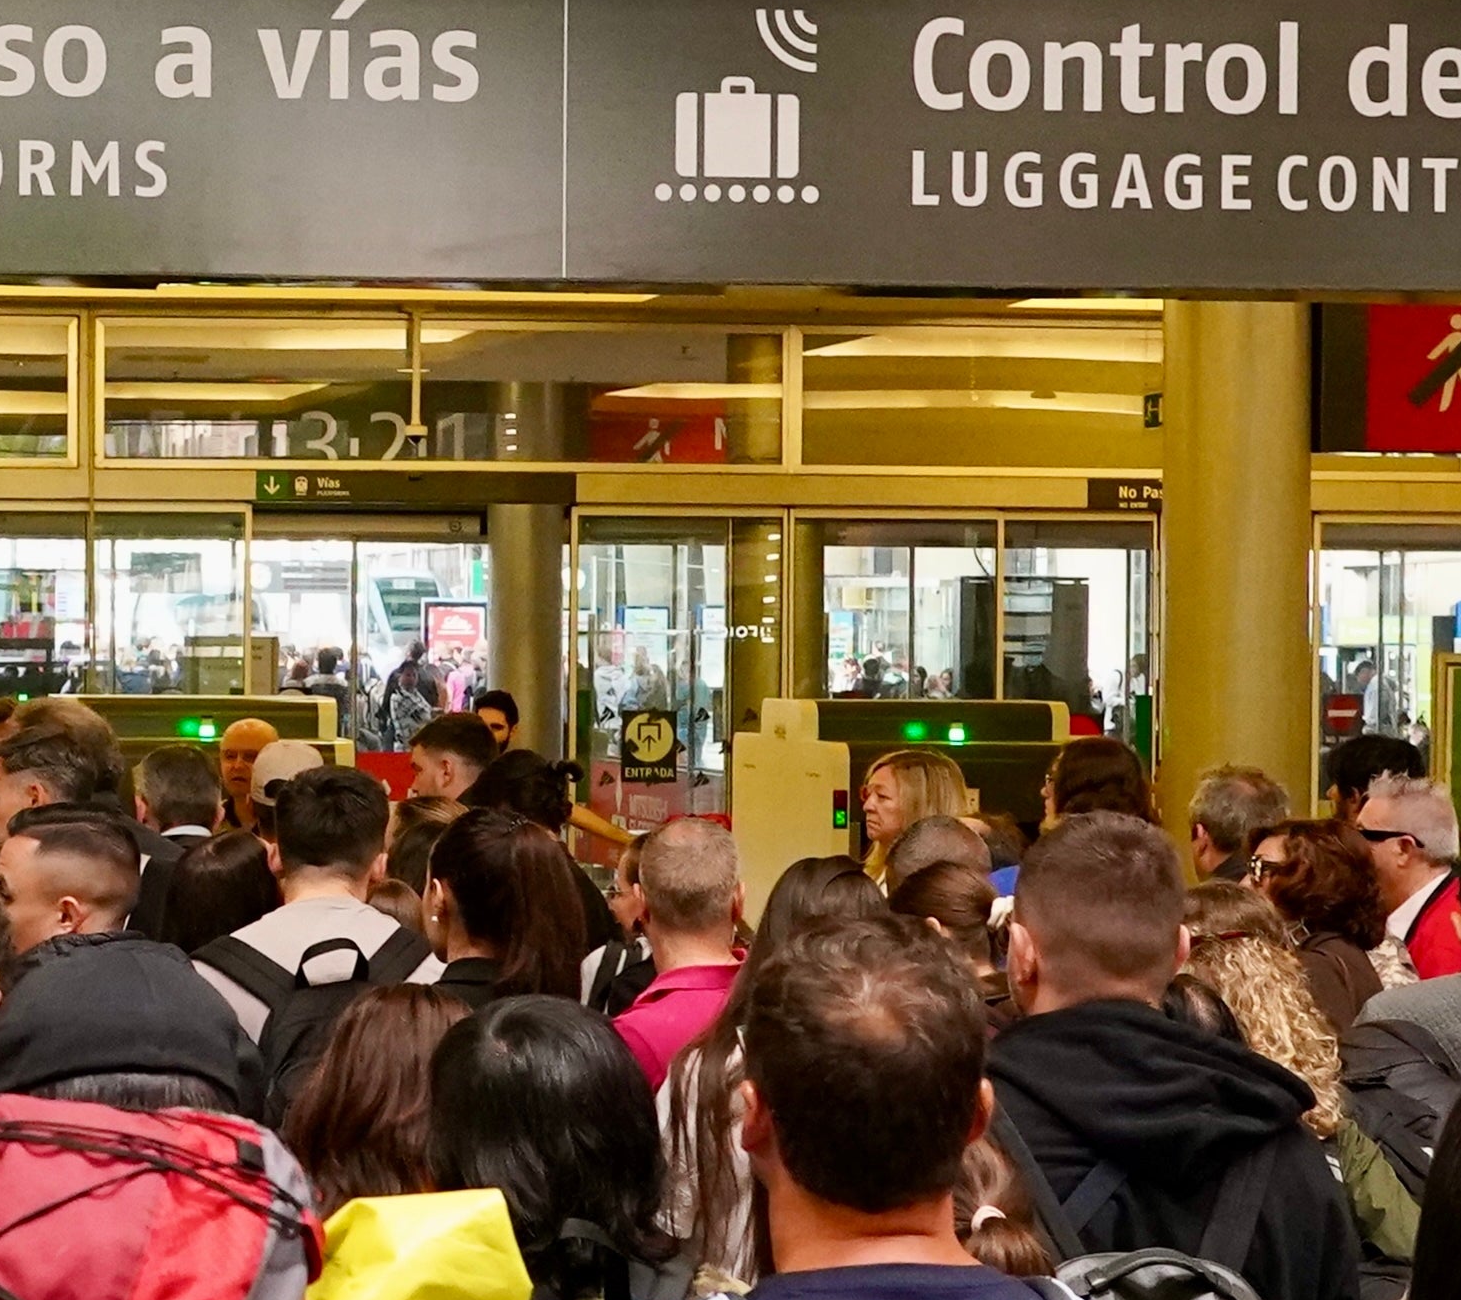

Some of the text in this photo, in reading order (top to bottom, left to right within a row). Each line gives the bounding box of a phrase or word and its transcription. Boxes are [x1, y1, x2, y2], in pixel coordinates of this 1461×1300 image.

[155, 22, 211, 100] a
[910, 17, 1301, 119] Control
[910, 152, 1255, 214] LUGGAGE
[317, 475, 341, 489] Vías
[1118, 485, 1138, 500] No
